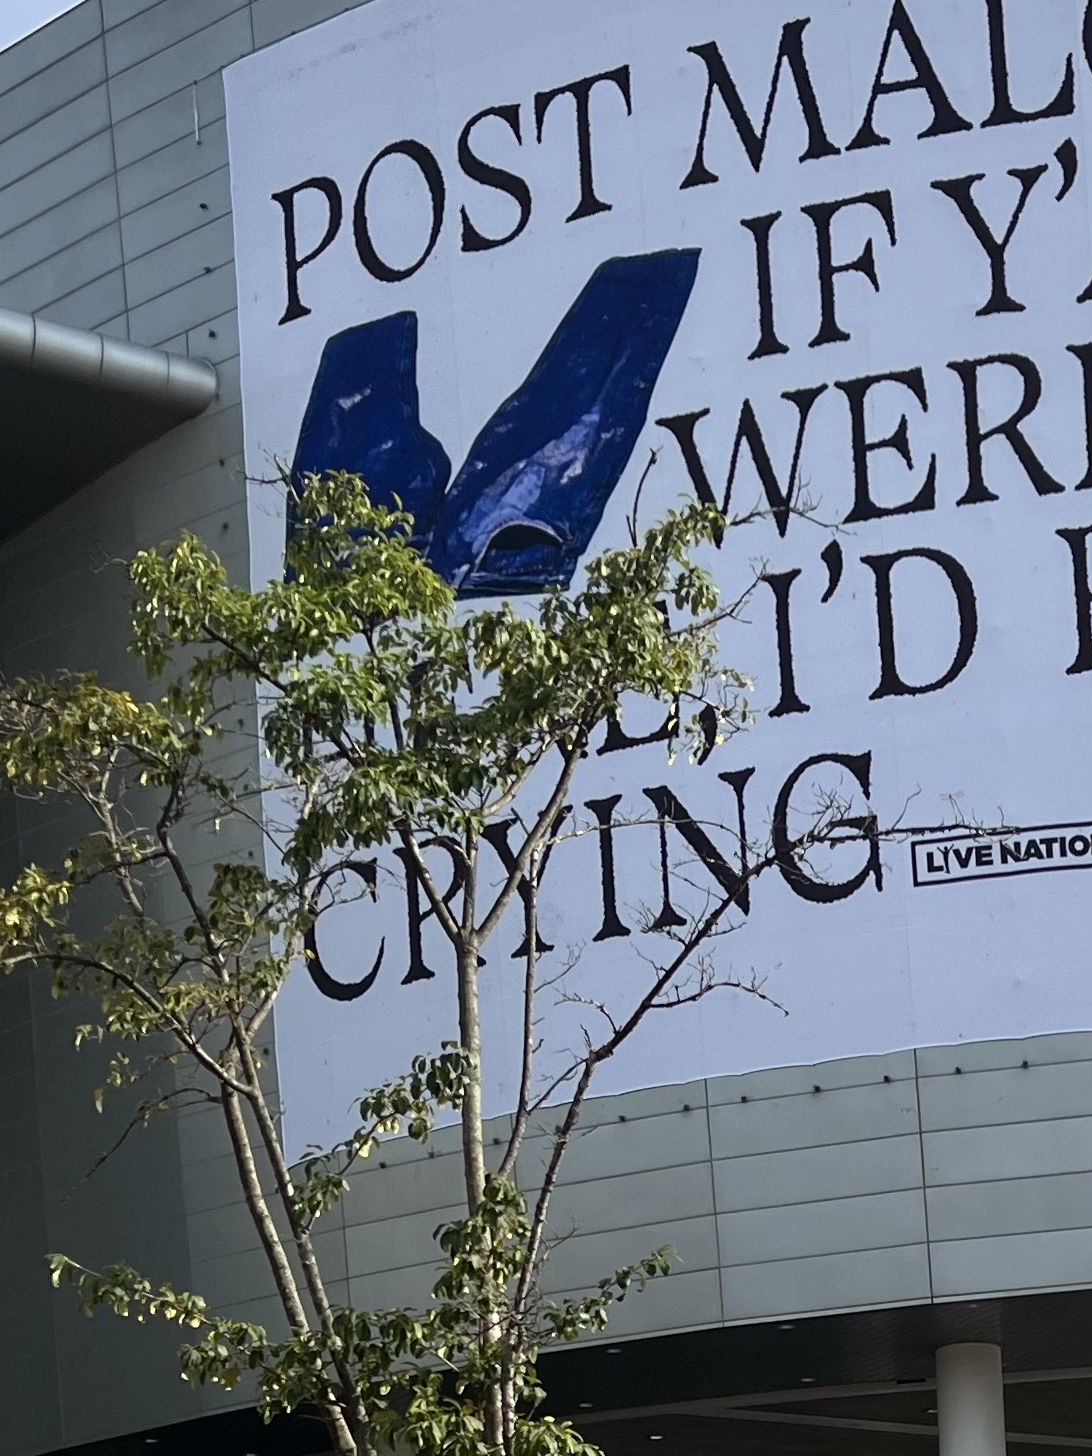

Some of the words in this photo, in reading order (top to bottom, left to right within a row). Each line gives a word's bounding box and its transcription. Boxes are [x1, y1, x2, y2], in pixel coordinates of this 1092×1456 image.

[270, 64, 632, 325] POST
[740, 189, 897, 360] IF
[762, 539, 978, 718] I'D
[926, 843, 994, 874] LIVE
